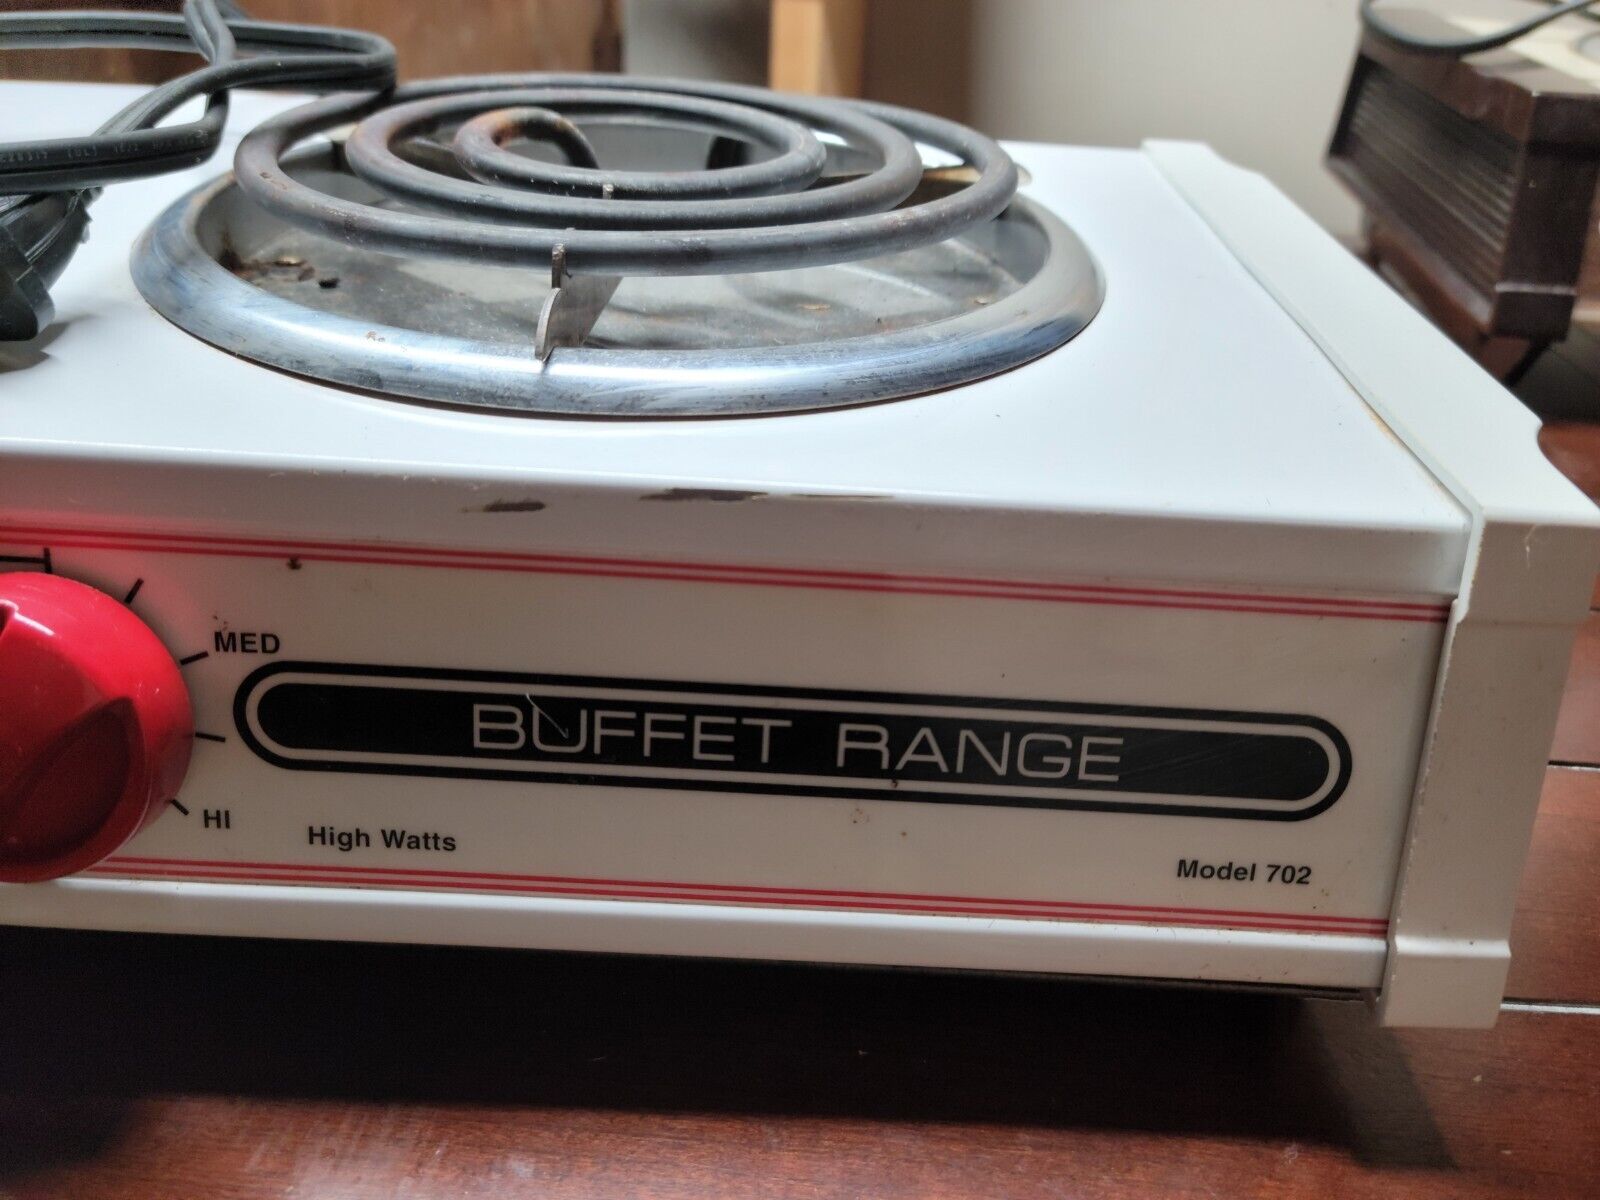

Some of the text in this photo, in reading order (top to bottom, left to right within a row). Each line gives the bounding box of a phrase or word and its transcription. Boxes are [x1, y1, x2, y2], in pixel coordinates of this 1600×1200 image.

[214, 632, 281, 655] MED
[473, 703, 1125, 783] BUFFET RANGE
[203, 808, 231, 829] HI
[308, 826, 457, 851] High Watts
[1177, 859, 1313, 886] Model 702
